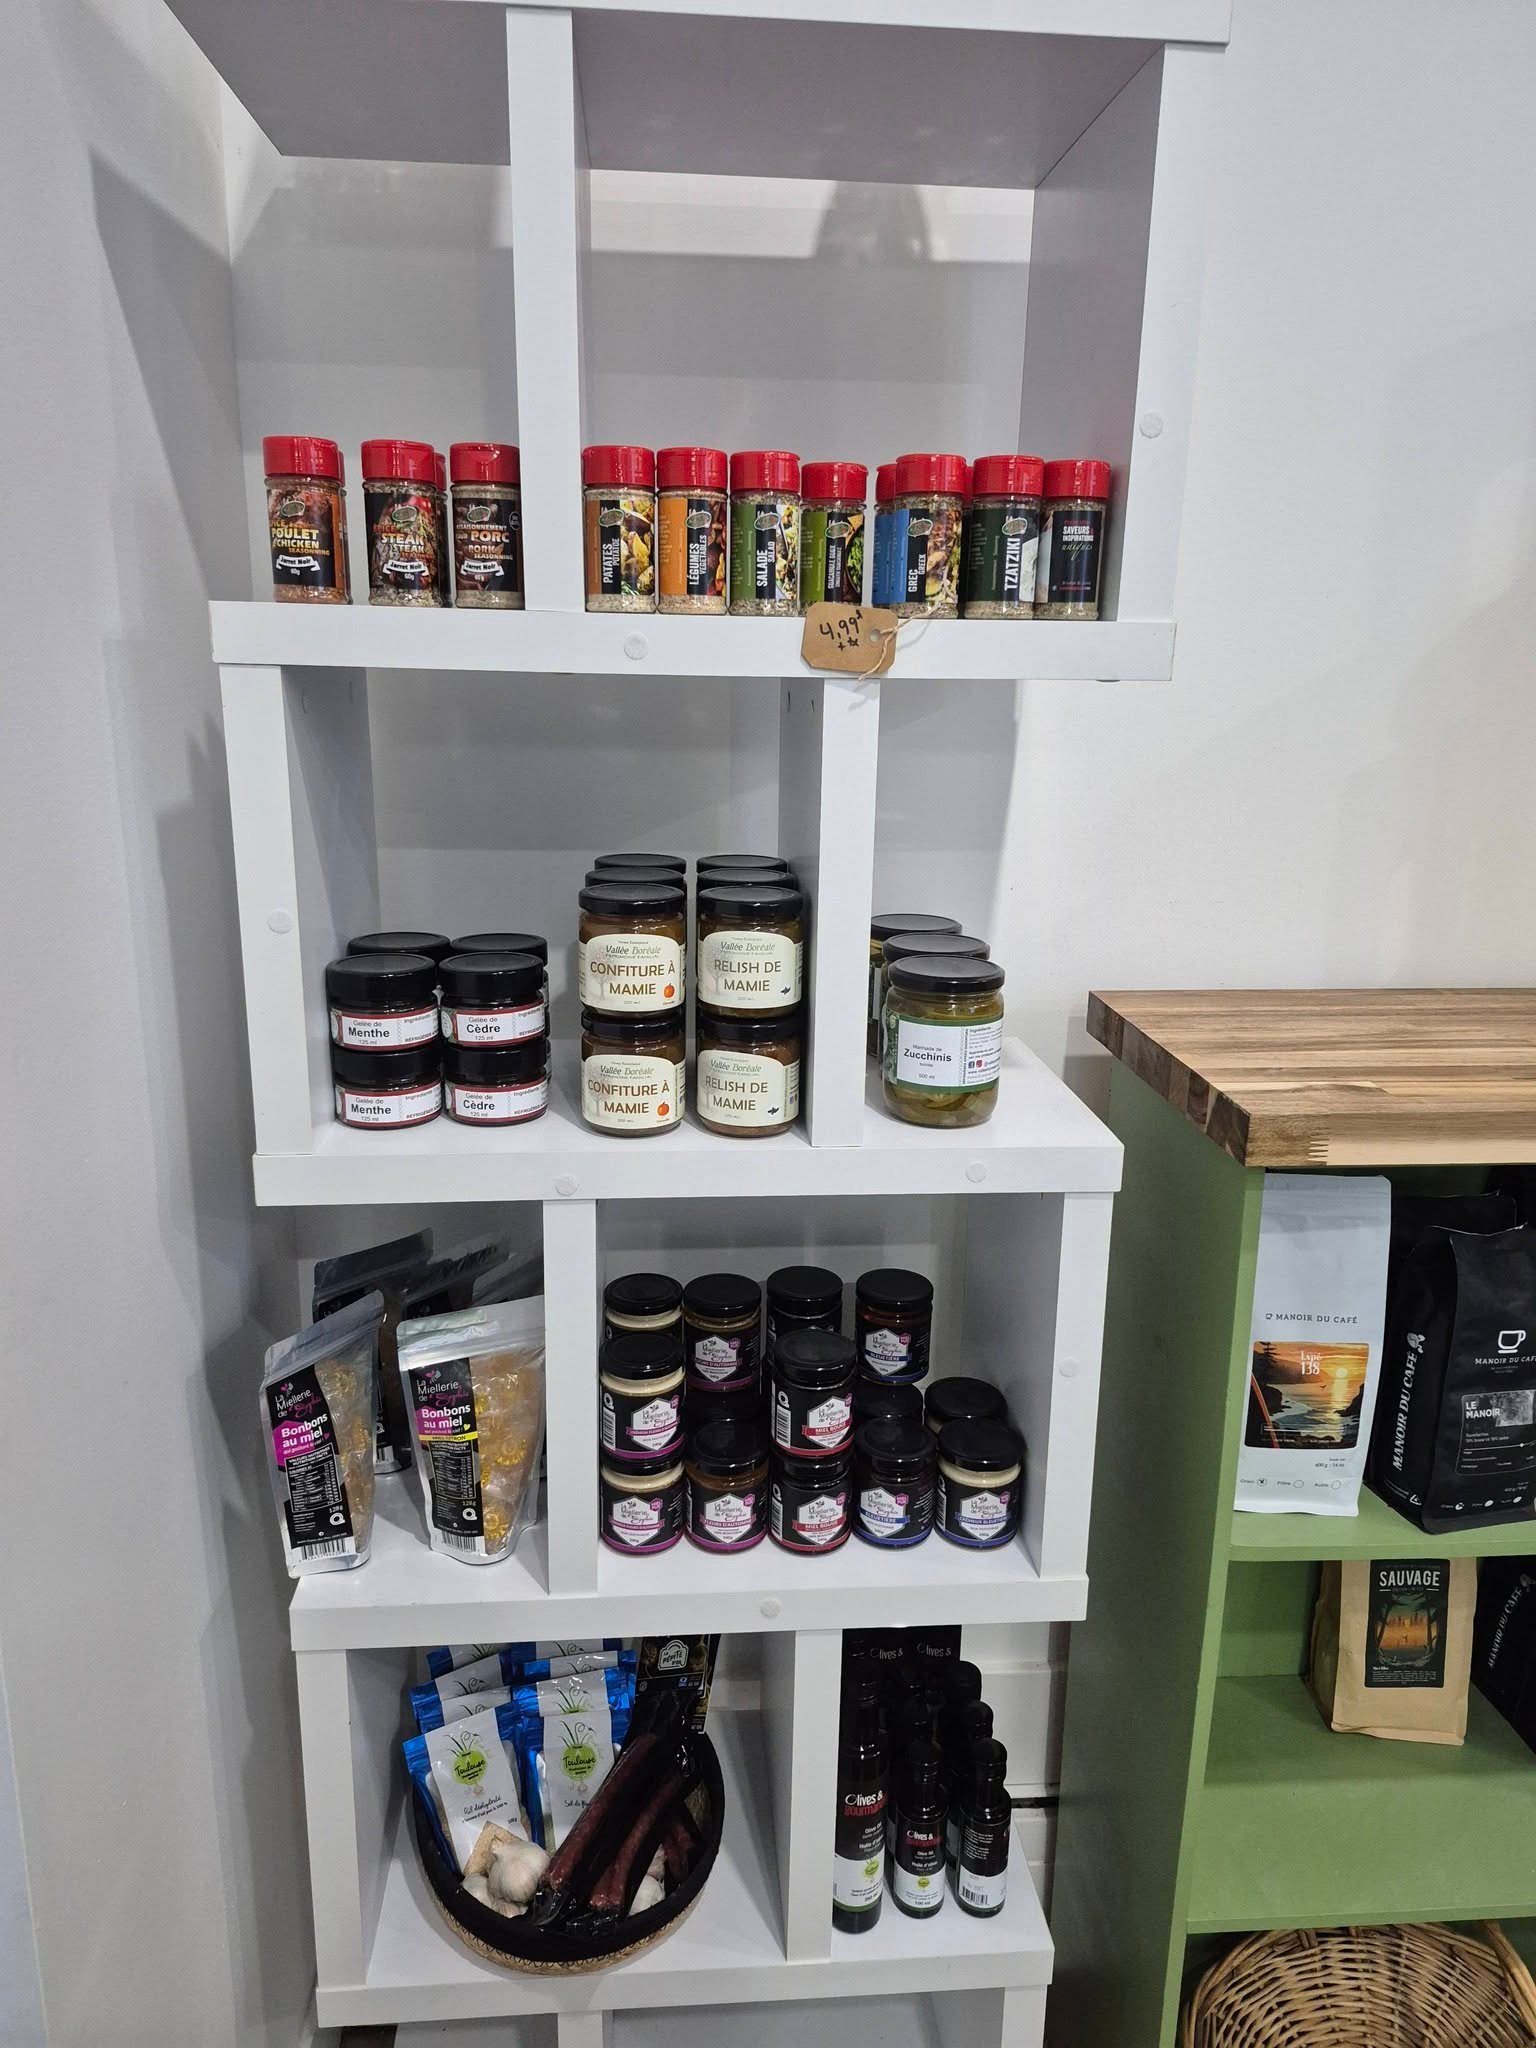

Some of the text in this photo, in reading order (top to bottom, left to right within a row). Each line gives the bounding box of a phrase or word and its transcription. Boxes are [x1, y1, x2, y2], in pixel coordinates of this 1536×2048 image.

[272, 528, 319, 540] POULET
[471, 531, 510, 542] PORC
[1063, 526, 1090, 535] SAVEURS
[381, 533, 424, 545] STEAK
[393, 544, 425, 554] STEAK
[468, 544, 496, 554] PORK
[767, 541, 776, 563] SALAD
[390, 562, 408, 570] Jarret
[603, 543, 614, 584] PATATES
[687, 543, 700, 585] LÉGUMES
[756, 549, 768, 587] SALADE
[918, 554, 926, 575] GREEK
[1004, 538, 1021, 591] TZATZIKI
[908, 569, 918, 592] GREC
[606, 945, 661, 955] Vallée Boréale
[720, 941, 776, 952] Vallée Boréale
[590, 959, 675, 977] CONFITURE À
[714, 959, 781, 974] RELISH DE
[609, 982, 656, 996] MAMIE
[724, 978, 770, 992] MAMIE
[348, 1027, 390, 1038] Menthe
[466, 1024, 501, 1034] Cèdre
[904, 1048, 952, 1062] Zucchinis
[587, 1079, 670, 1097] CONFITURE À
[705, 1075, 768, 1093] RELISH DE
[351, 1103, 392, 1115] Menthe
[463, 1100, 495, 1111] Cèdre
[604, 1101, 649, 1114] MAMIE
[713, 1095, 756, 1111] MAMIE
[1276, 1313, 1358, 1324] MANOIR DU CAFÉ
[1475, 1357, 1507, 1365] MANOIR
[1301, 1362, 1321, 1375] 138
[417, 1379, 426, 1387] La
[418, 1381, 459, 1395] Miellerie
[275, 1394, 284, 1402] La
[277, 1389, 311, 1411] Miellerie
[422, 1404, 471, 1419] Bonbons
[1392, 1351, 1418, 1471] MANOIR DU CAFÉ
[1466, 1401, 1477, 1410] LE
[278, 1410, 288, 1418] de
[1466, 1408, 1501, 1419] MANOIR
[281, 1413, 328, 1438] Bonbons
[424, 1415, 462, 1429] au miel
[282, 1426, 323, 1448] au miel
[1379, 1570, 1440, 1587] SAUVAGE
[870, 1647, 897, 1660] Olives
[917, 1643, 944, 1657] Olives
[454, 1760, 486, 1777] Toulouse
[563, 1755, 596, 1769] Toulouse
[845, 1789, 883, 1807] Olives &
[906, 1830, 928, 1841] Olives
